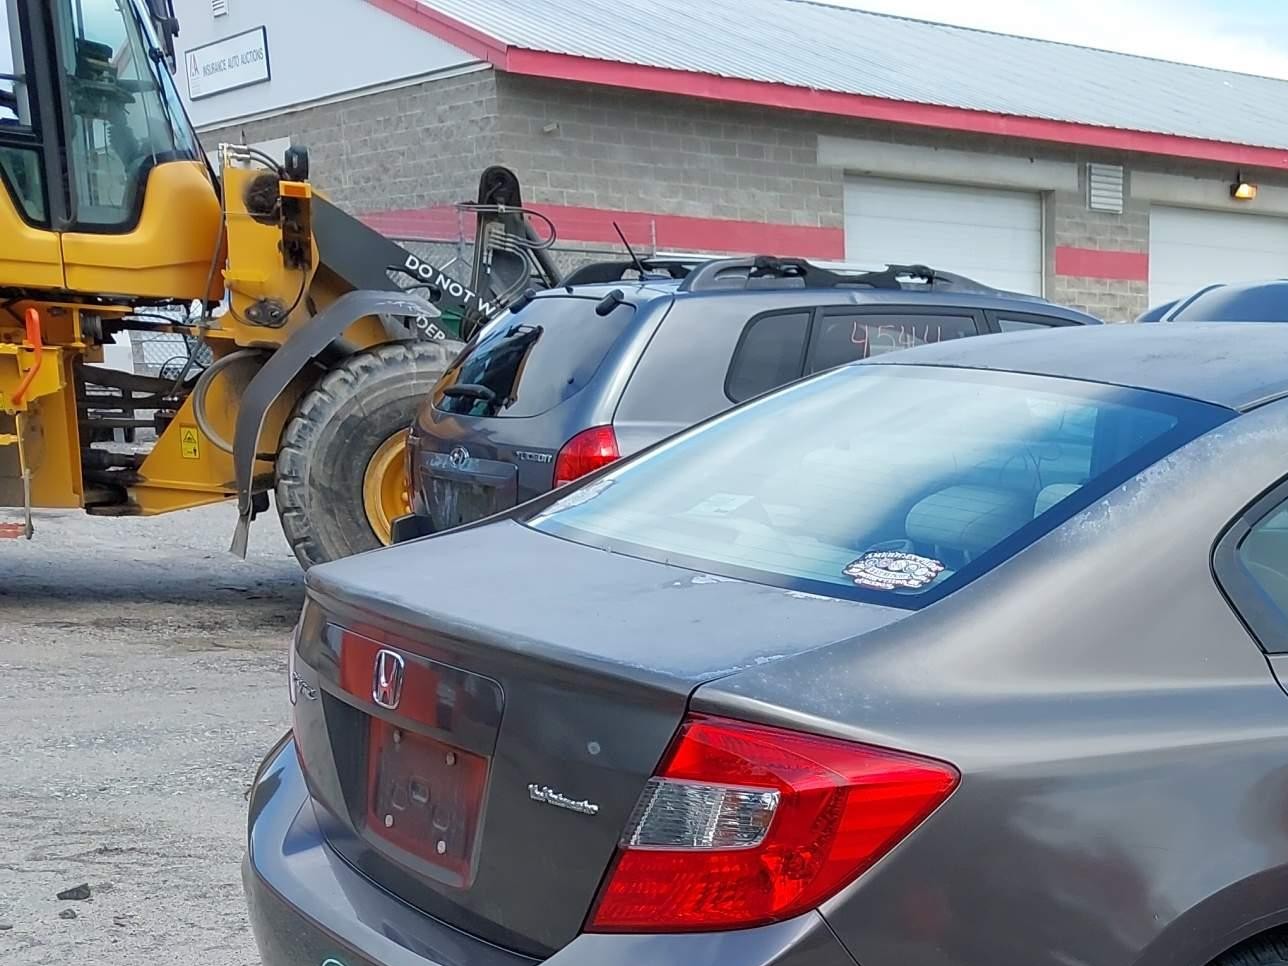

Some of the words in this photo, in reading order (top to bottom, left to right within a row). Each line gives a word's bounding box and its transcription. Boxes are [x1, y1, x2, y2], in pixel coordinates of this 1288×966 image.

[203, 59, 227, 77] INSURANCE
[227, 55, 239, 69] AUTO
[240, 48, 264, 65] AUCTIONS
[405, 254, 433, 278] DO
[435, 273, 475, 302] NOT
[478, 297, 497, 317] W
